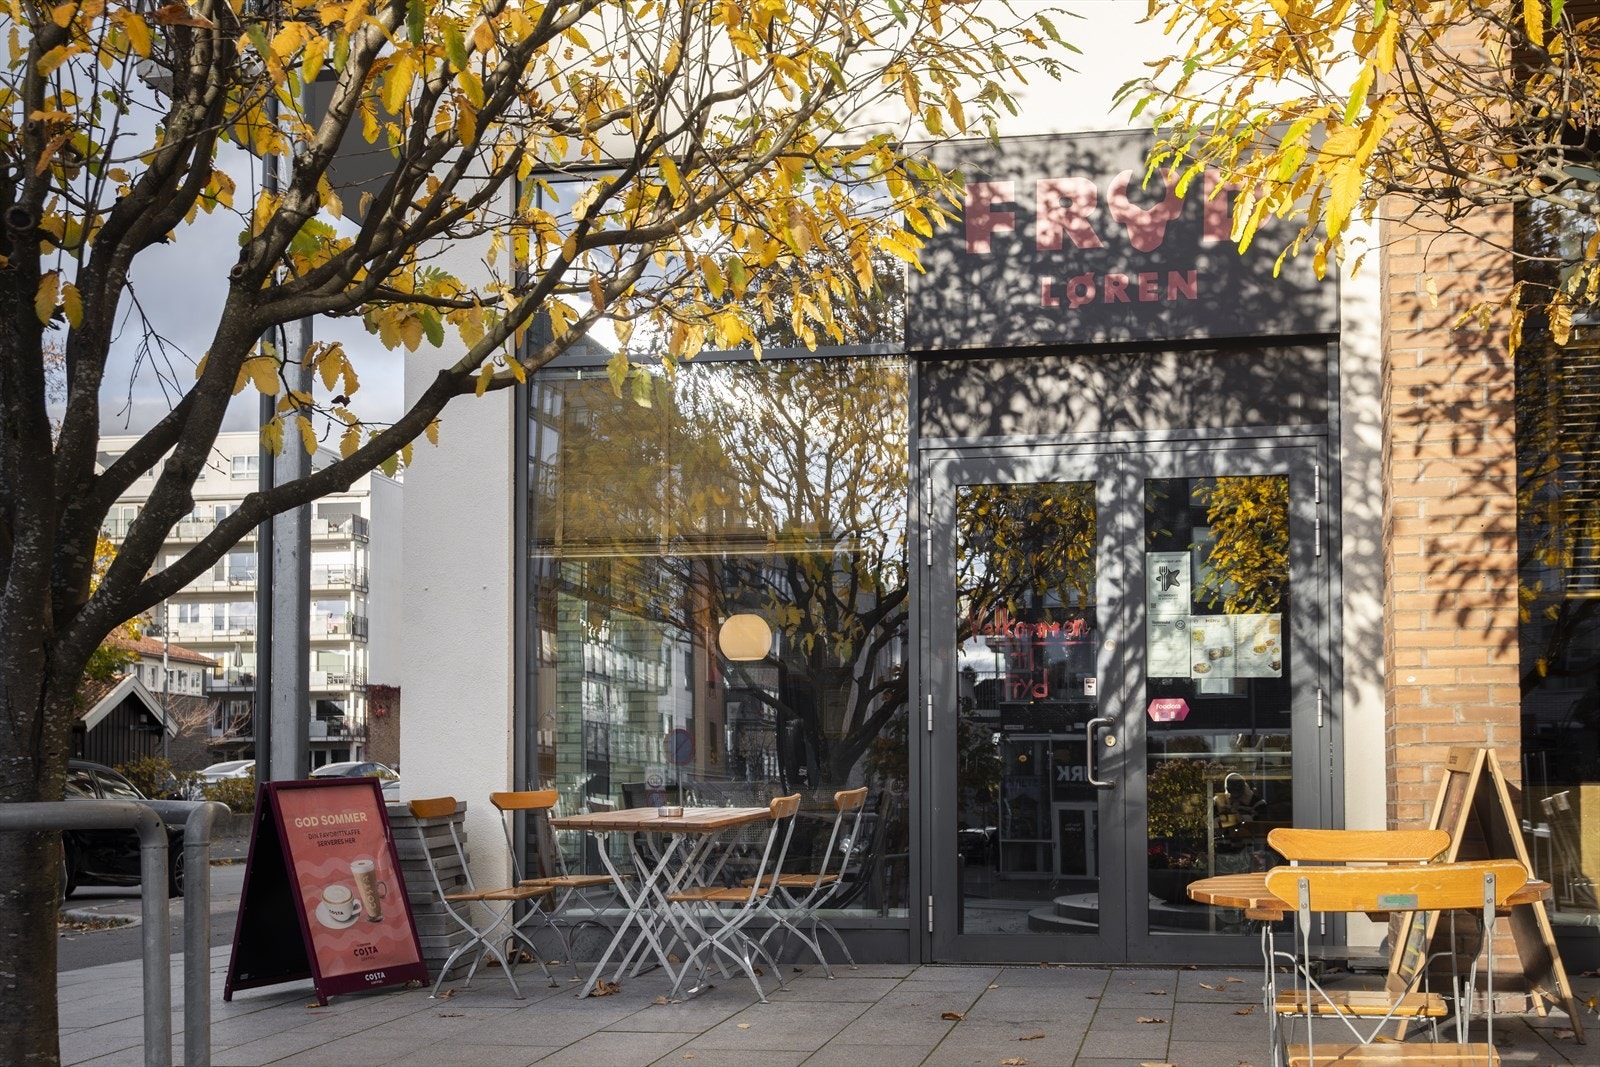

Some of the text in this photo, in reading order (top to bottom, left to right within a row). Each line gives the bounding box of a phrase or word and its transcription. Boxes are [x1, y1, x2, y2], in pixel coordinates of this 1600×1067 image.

[1041, 270, 1198, 309] LØREN
[294, 812, 368, 828] GOD SOMMER
[353, 945, 379, 957] COSTA
[364, 971, 386, 981] COSTA
